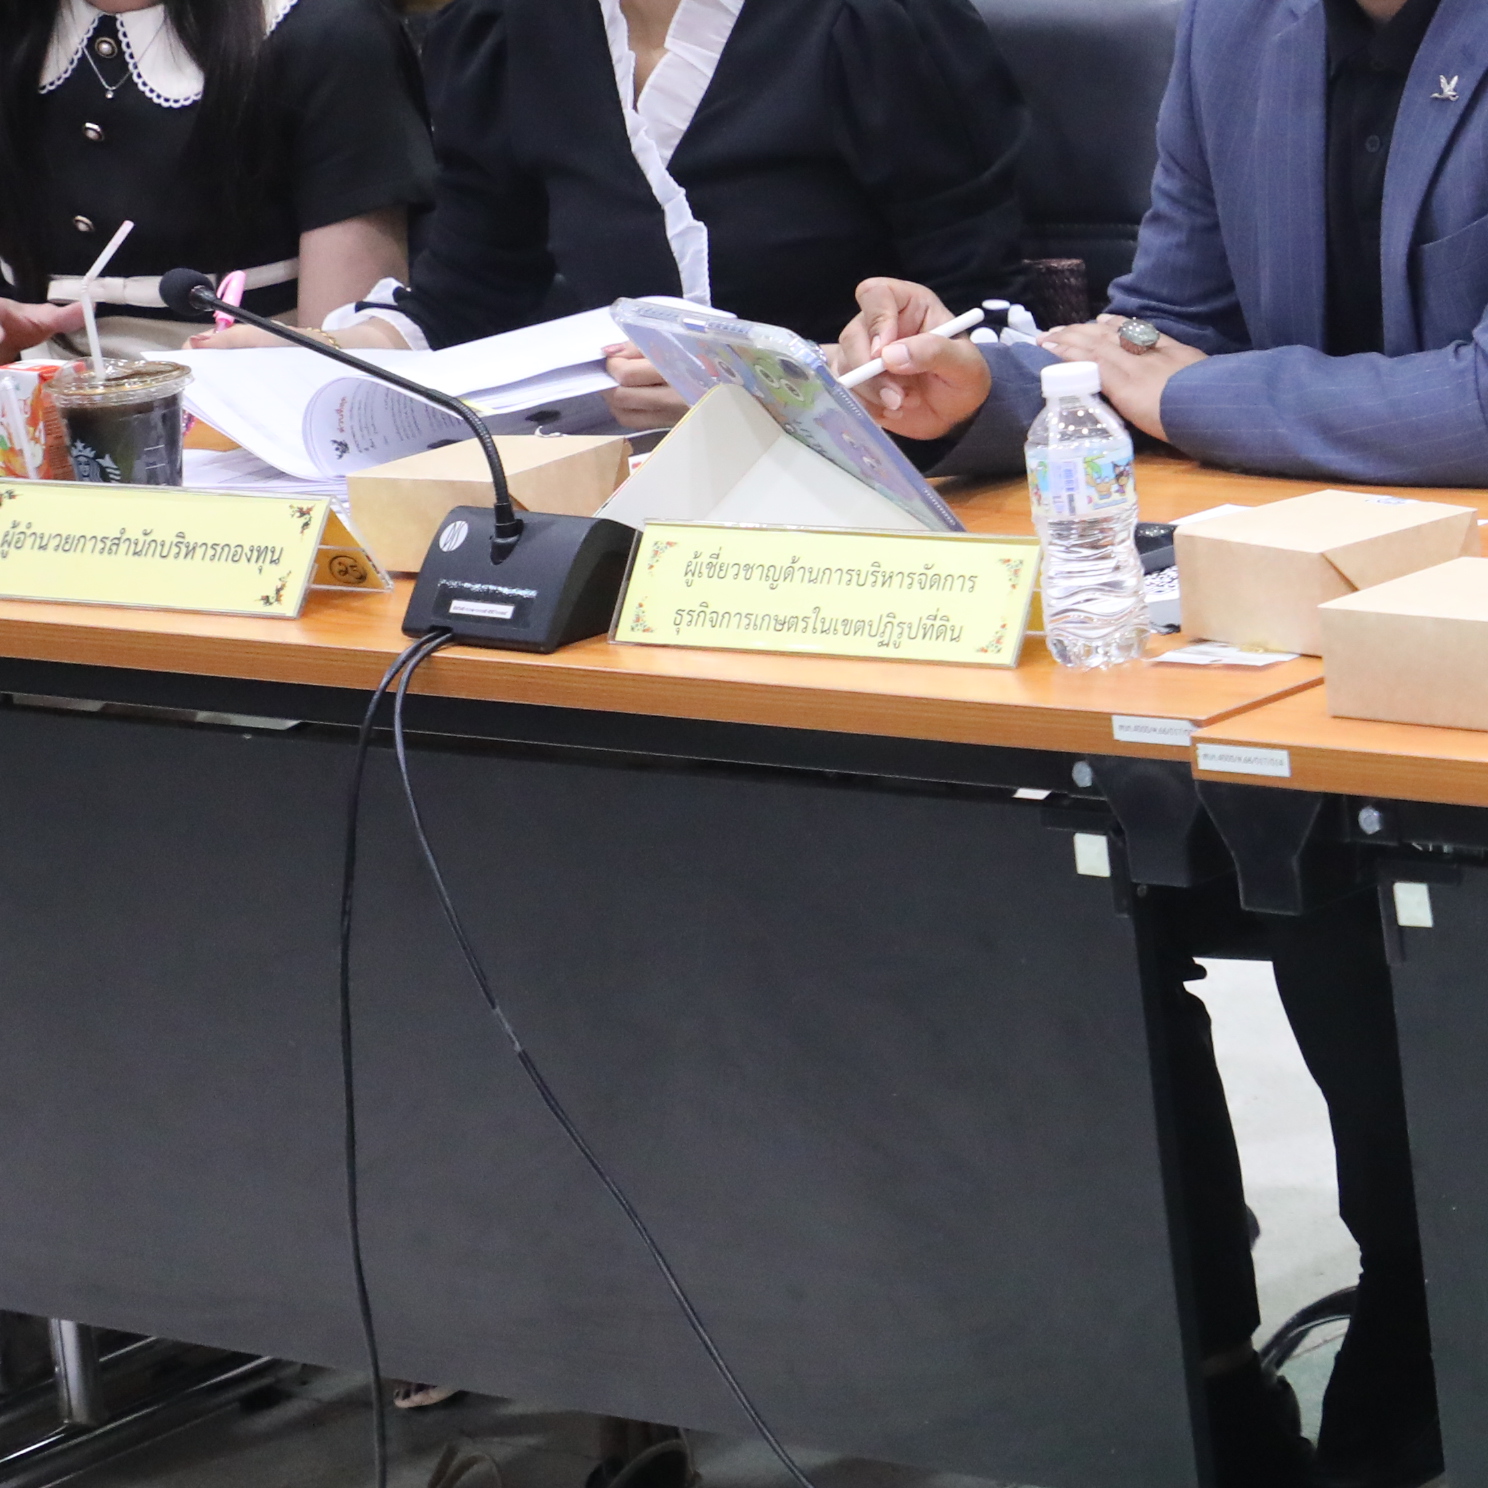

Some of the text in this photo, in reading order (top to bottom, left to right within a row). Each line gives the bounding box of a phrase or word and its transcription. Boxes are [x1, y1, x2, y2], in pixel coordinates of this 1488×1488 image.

[0, 519, 284, 575] ผู้อำนวยการสำนักบริหารกองทุน
[683, 546, 978, 593] ผู้เชี่ยวชาญด้านการบริหารจัดการ
[672, 601, 964, 650] ธุรกิจการเกษตรในเขตปฏิรูปที่ดิน
